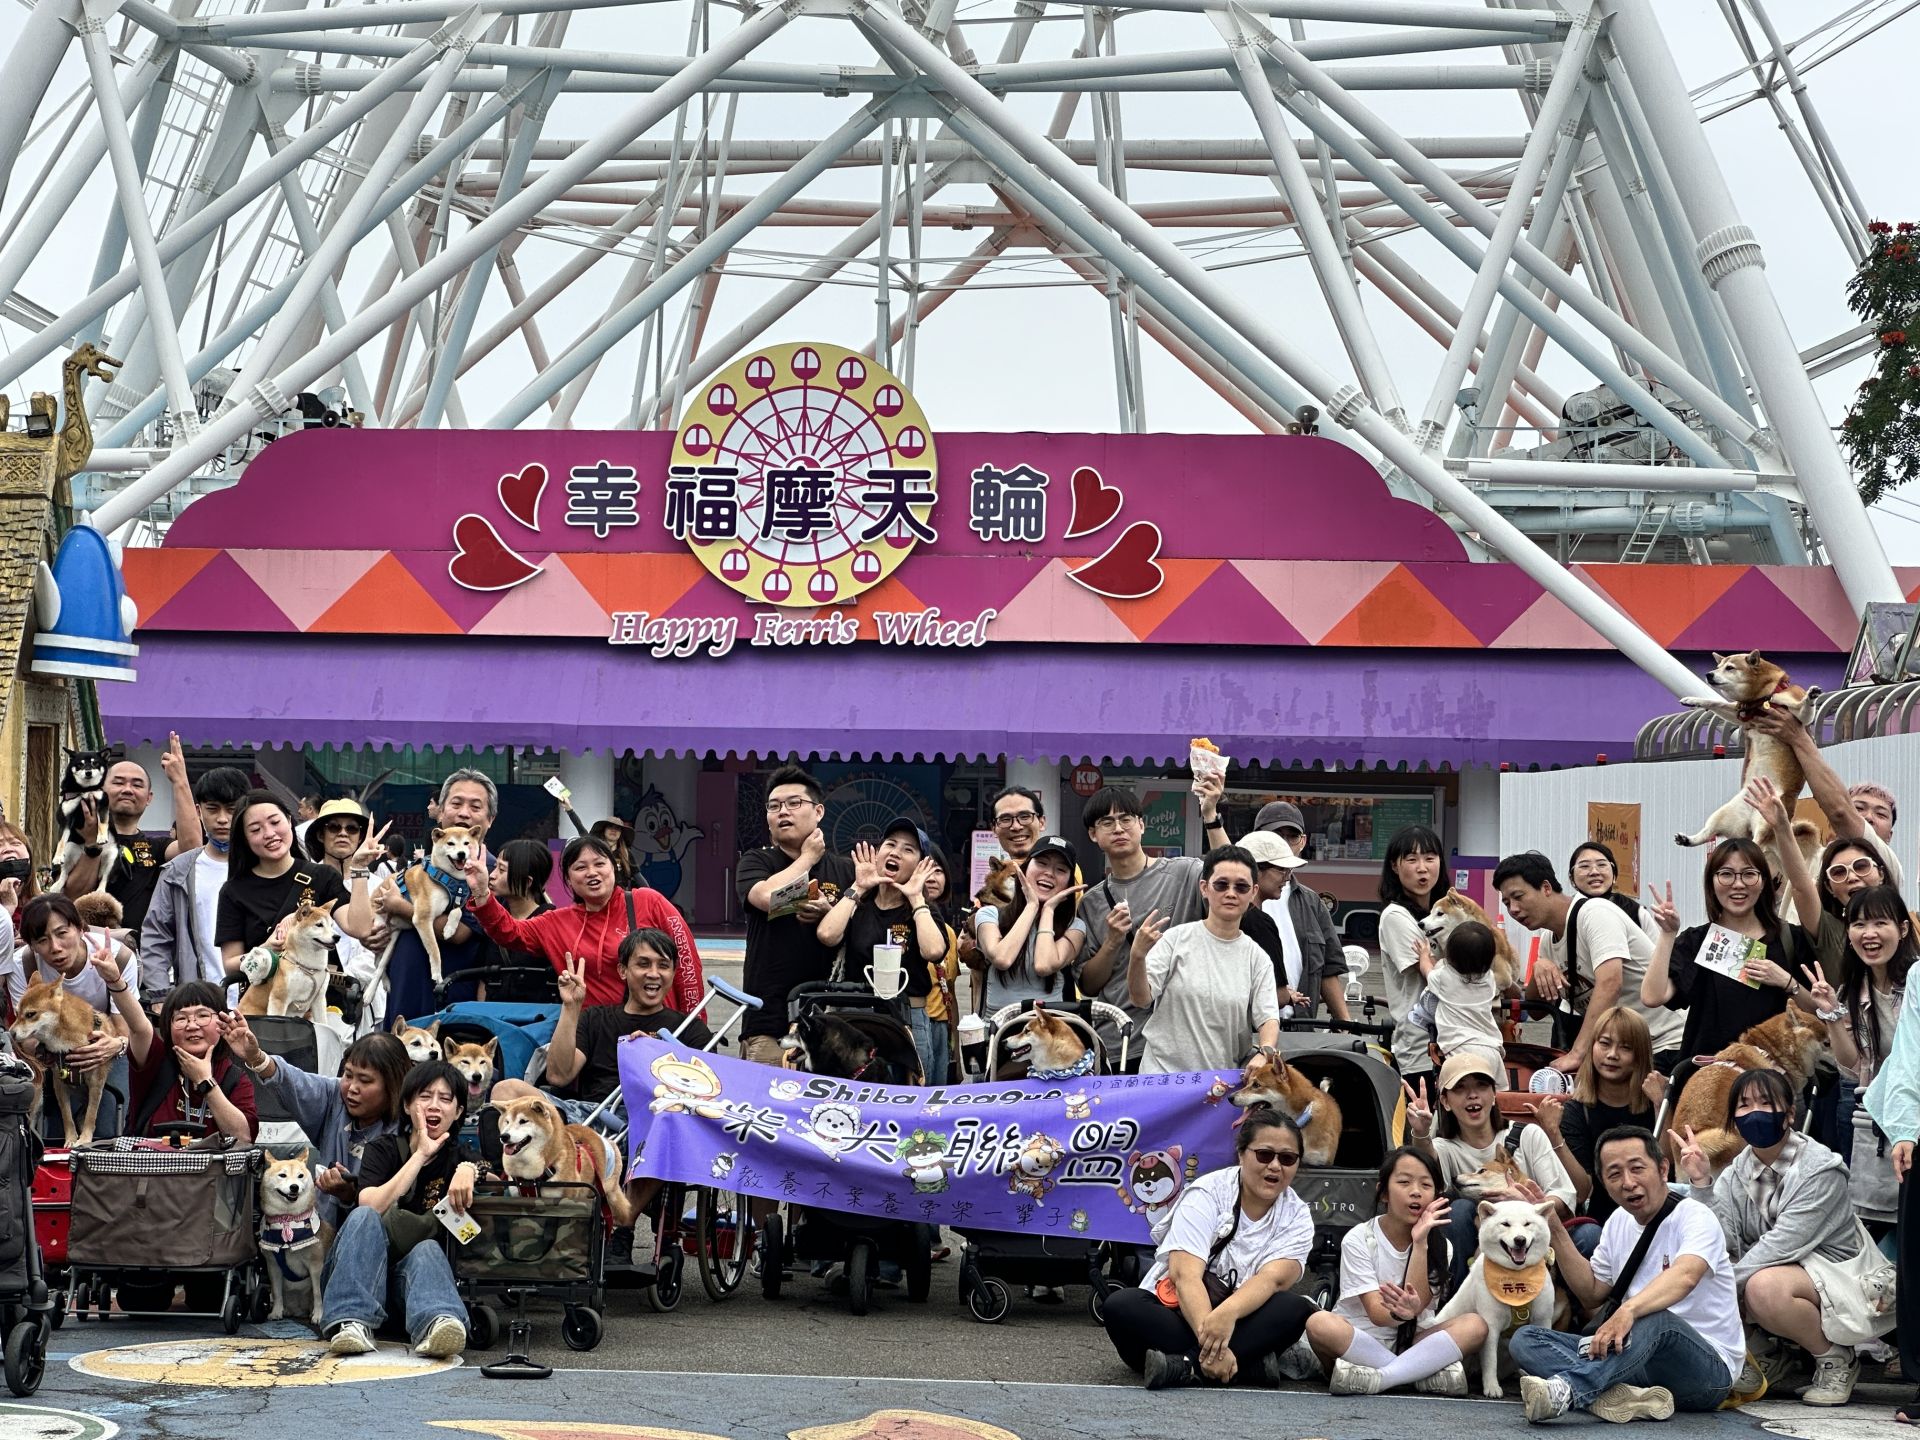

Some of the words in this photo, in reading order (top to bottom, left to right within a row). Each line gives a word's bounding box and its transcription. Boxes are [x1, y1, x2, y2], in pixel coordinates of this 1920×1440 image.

[565, 459, 1049, 544] 幸福摩天輪
[608, 610, 737, 658] Happy
[750, 610, 861, 645] Ferris
[872, 606, 998, 648] Wheel
[1157, 826, 1180, 838] Bus
[802, 1078, 918, 1106] Shiba
[923, 1089, 1063, 1106] League
[723, 1108, 1141, 1186] 柴犬聯盟
[1306, 1195, 1355, 1213] TSTRO
[1502, 1283, 1527, 1295] 元元
